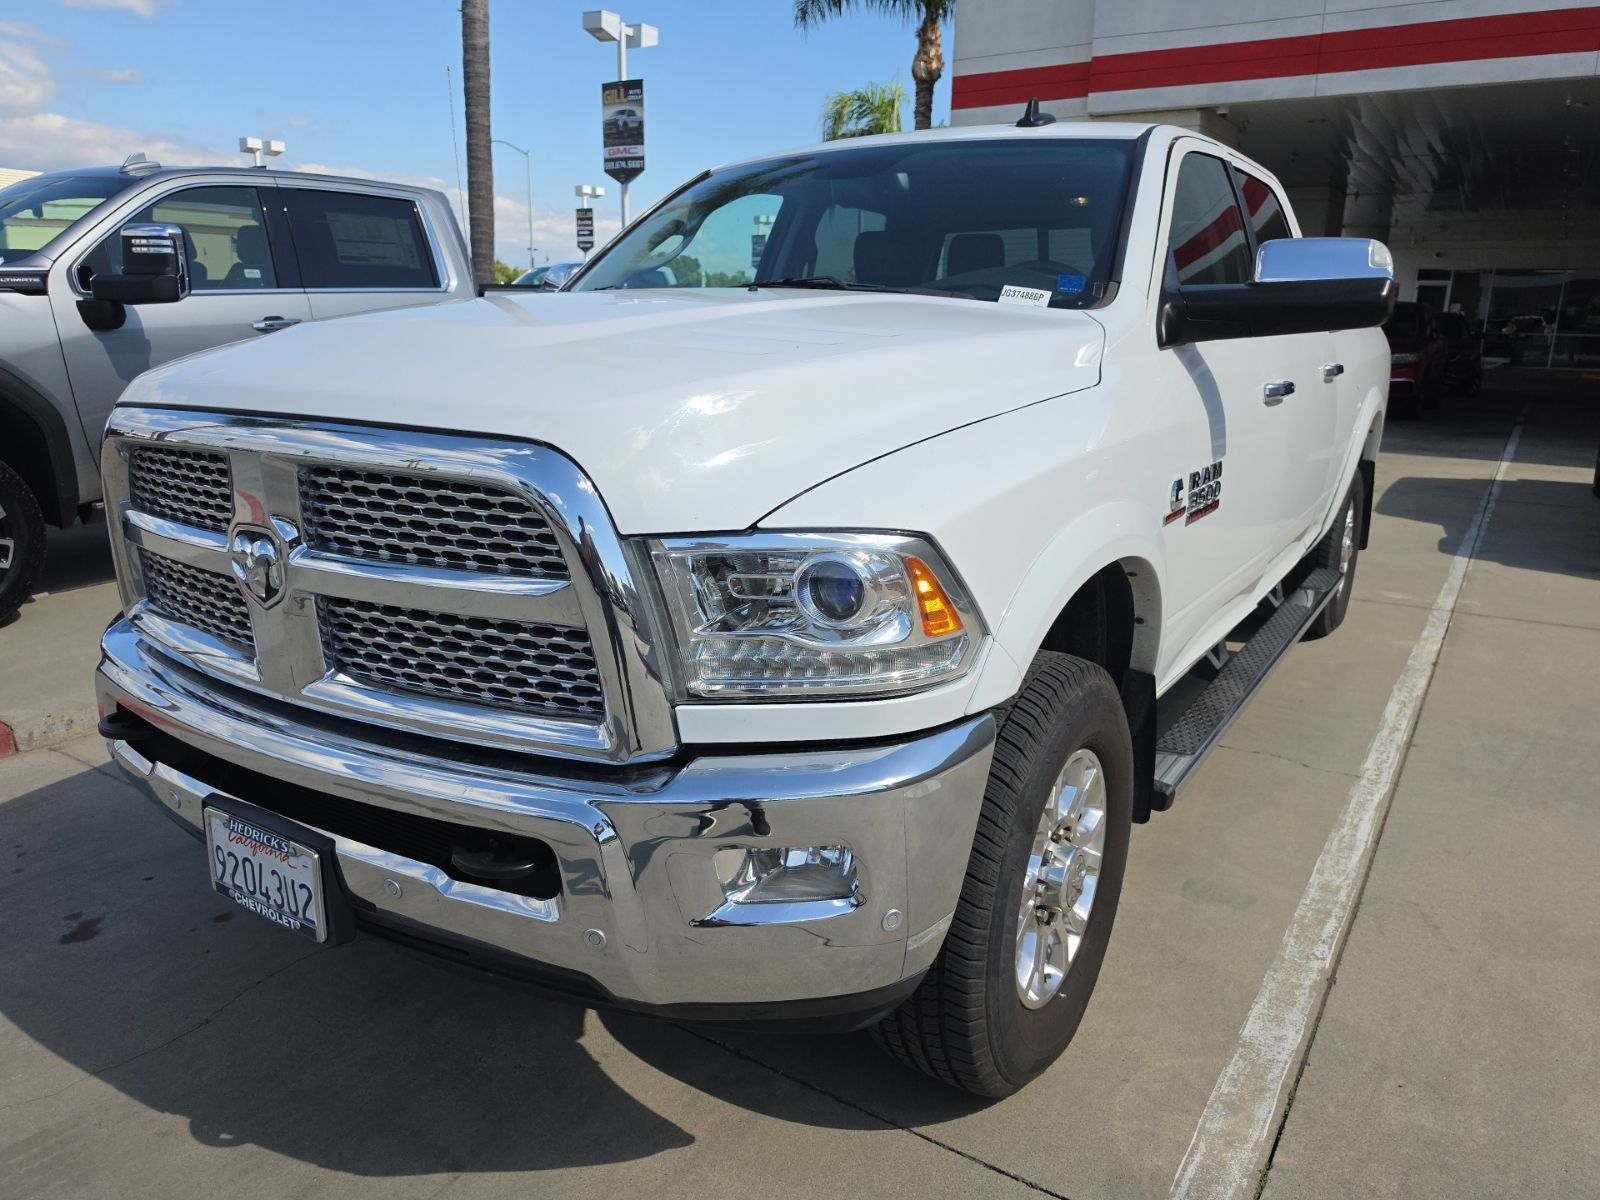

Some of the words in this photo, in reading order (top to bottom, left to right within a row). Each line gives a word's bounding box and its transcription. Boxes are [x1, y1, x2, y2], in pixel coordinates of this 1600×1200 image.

[604, 88, 627, 104] GILL
[607, 147, 639, 156] GMC
[1002, 288, 1045, 301] JG374886P
[1188, 460, 1223, 494] RAM
[229, 819, 289, 853] HEDRICK'S
[215, 844, 317, 928] 92043U2
[234, 891, 295, 930] CHEVROLET
